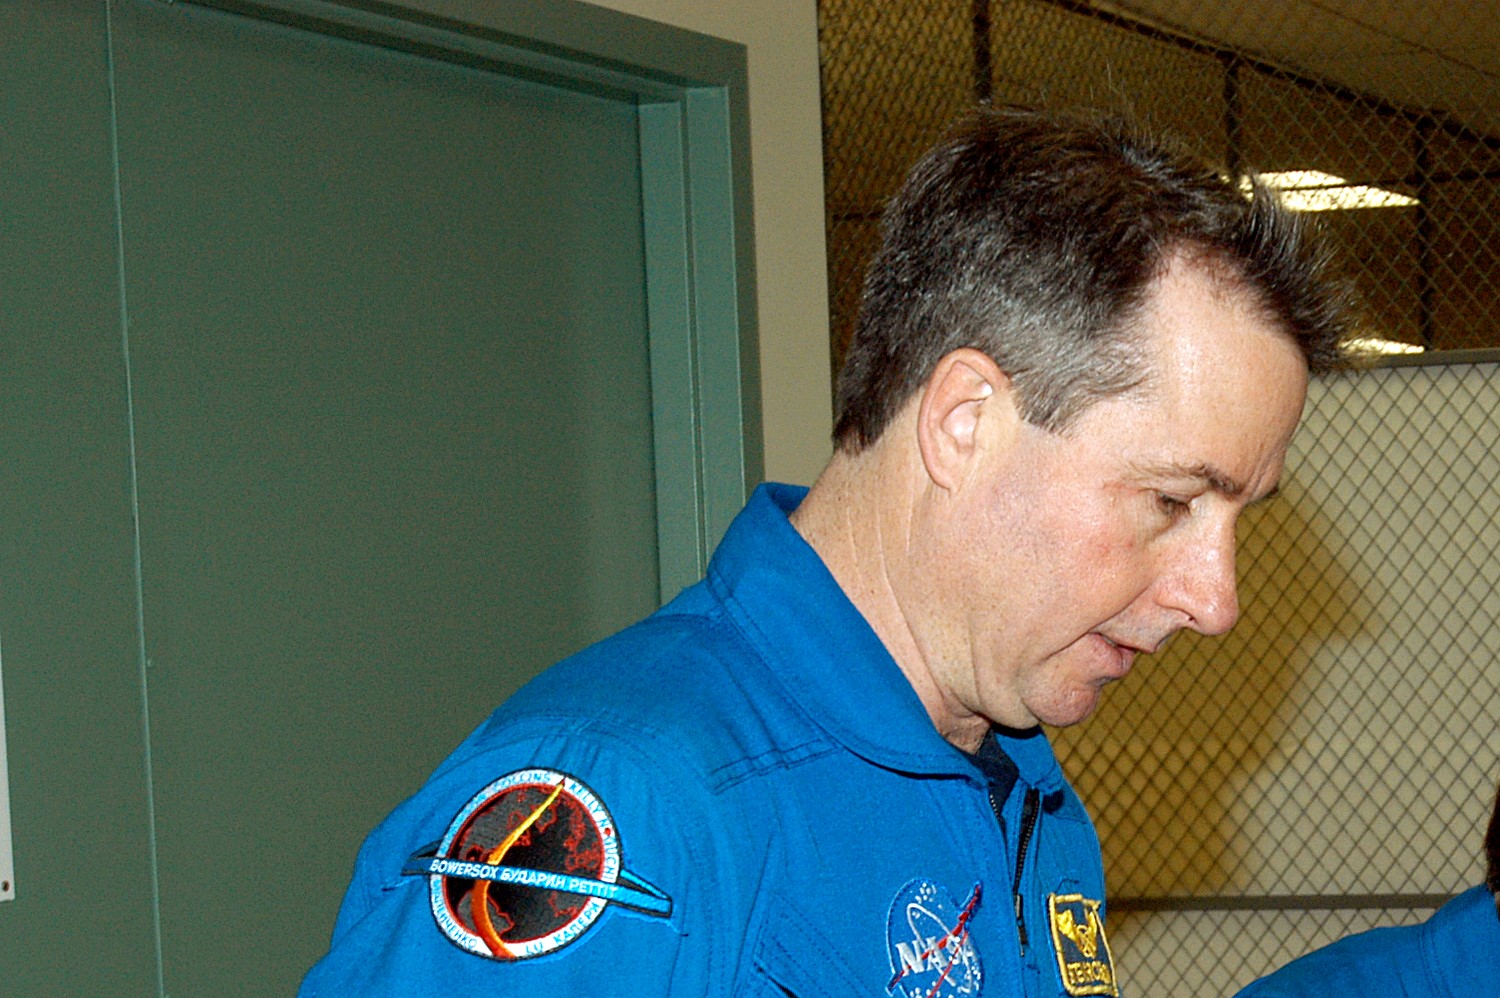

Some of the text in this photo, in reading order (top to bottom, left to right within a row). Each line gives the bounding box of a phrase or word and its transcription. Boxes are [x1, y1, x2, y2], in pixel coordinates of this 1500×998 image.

[569, 783, 602, 812] KELLY
[428, 859, 618, 898] BOWERSOX БУДАРИН PETTIT
[525, 941, 544, 955] LU
[896, 934, 978, 976] NASA
